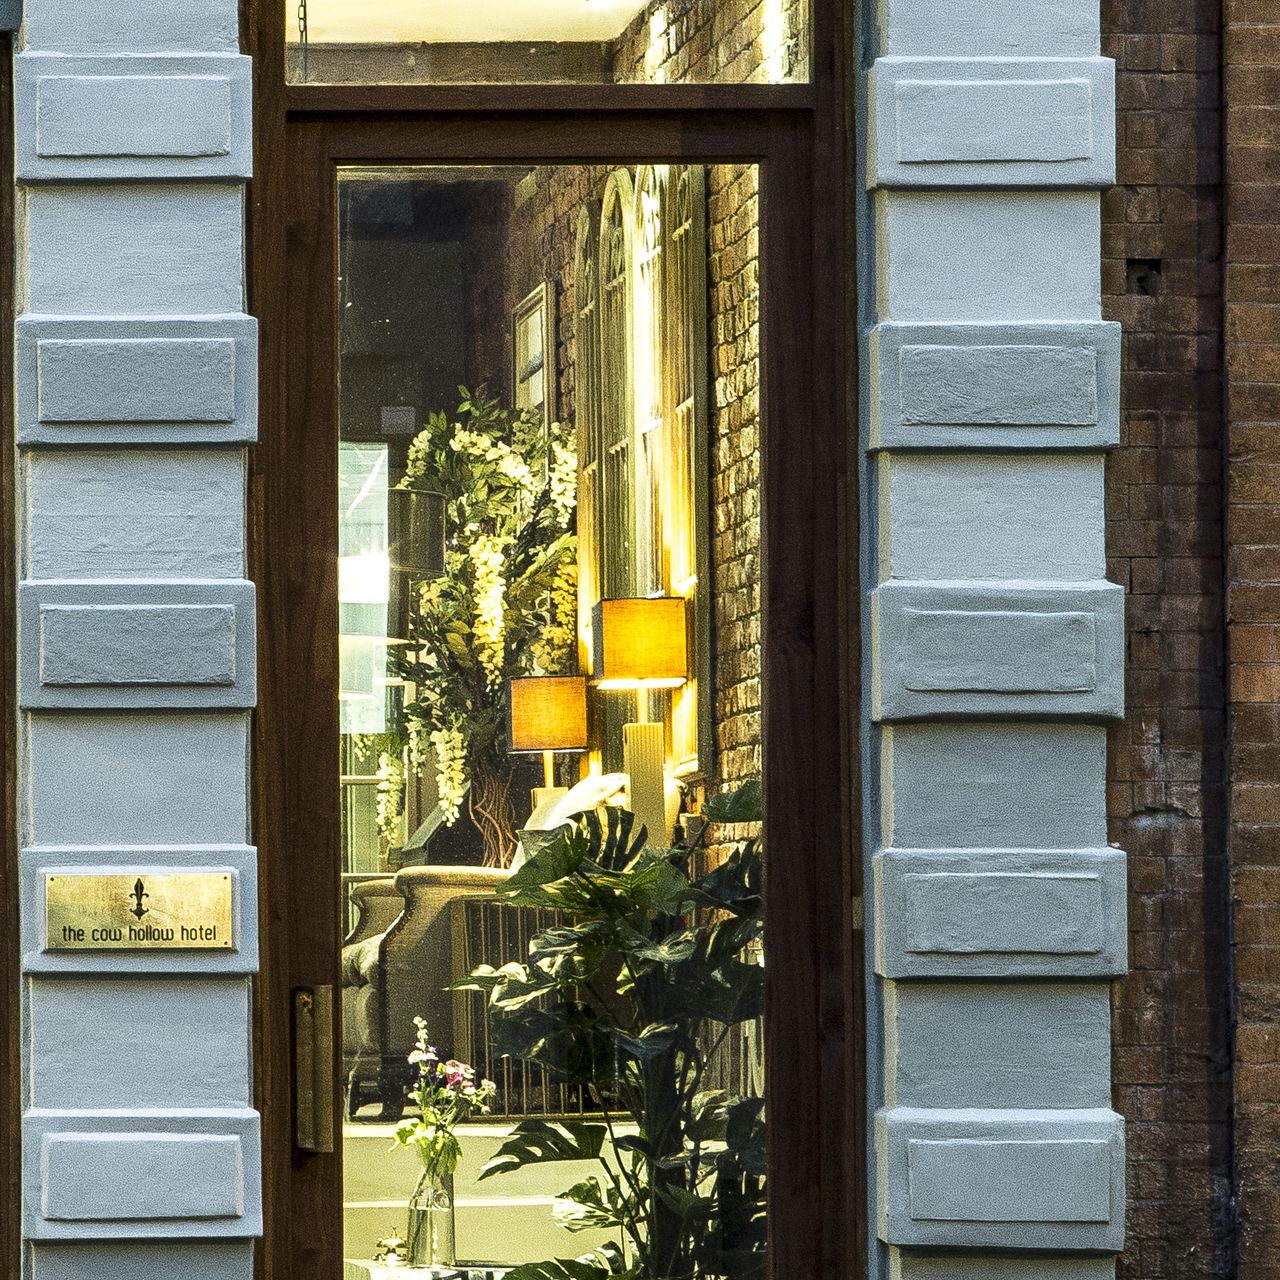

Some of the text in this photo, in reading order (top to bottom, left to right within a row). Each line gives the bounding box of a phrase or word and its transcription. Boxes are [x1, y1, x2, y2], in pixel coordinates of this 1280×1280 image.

[62, 925, 216, 941] the cow hollow hotel
